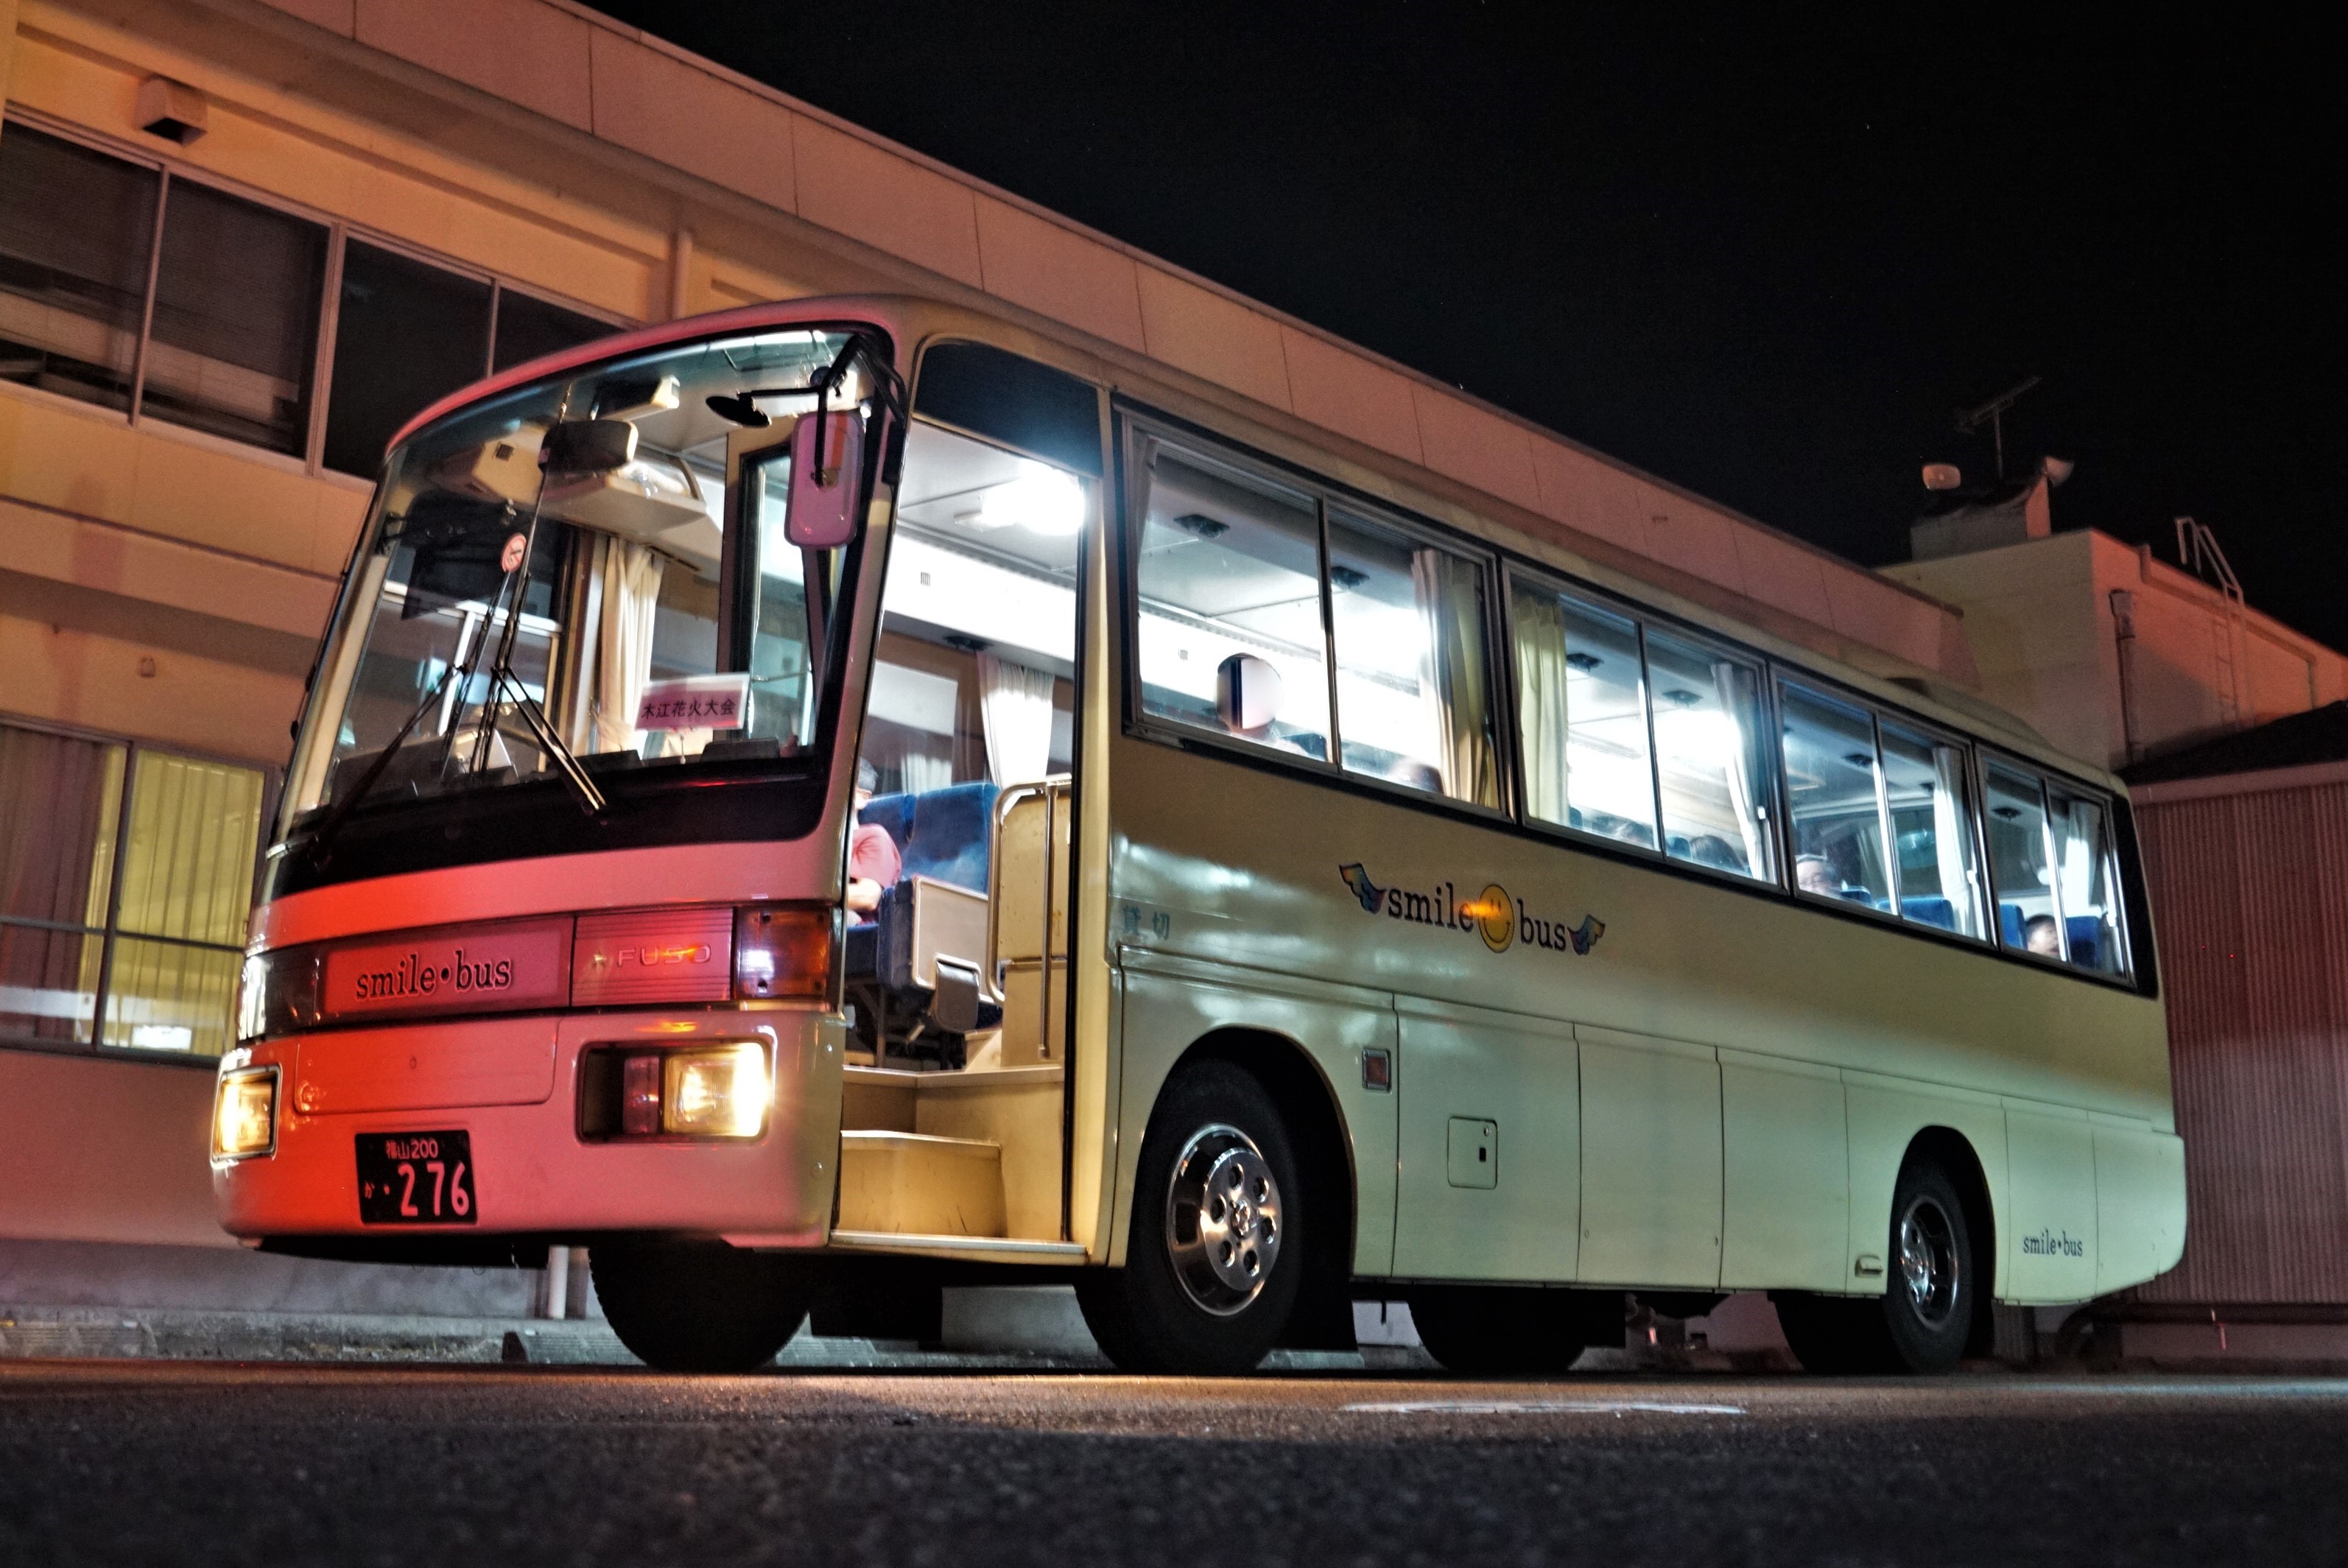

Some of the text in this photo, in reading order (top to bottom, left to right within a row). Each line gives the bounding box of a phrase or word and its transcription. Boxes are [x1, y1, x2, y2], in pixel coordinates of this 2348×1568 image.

[641, 697, 736, 720] 木江花火大会
[1387, 882, 1566, 952] smile bus
[616, 942, 713, 968] FUSO
